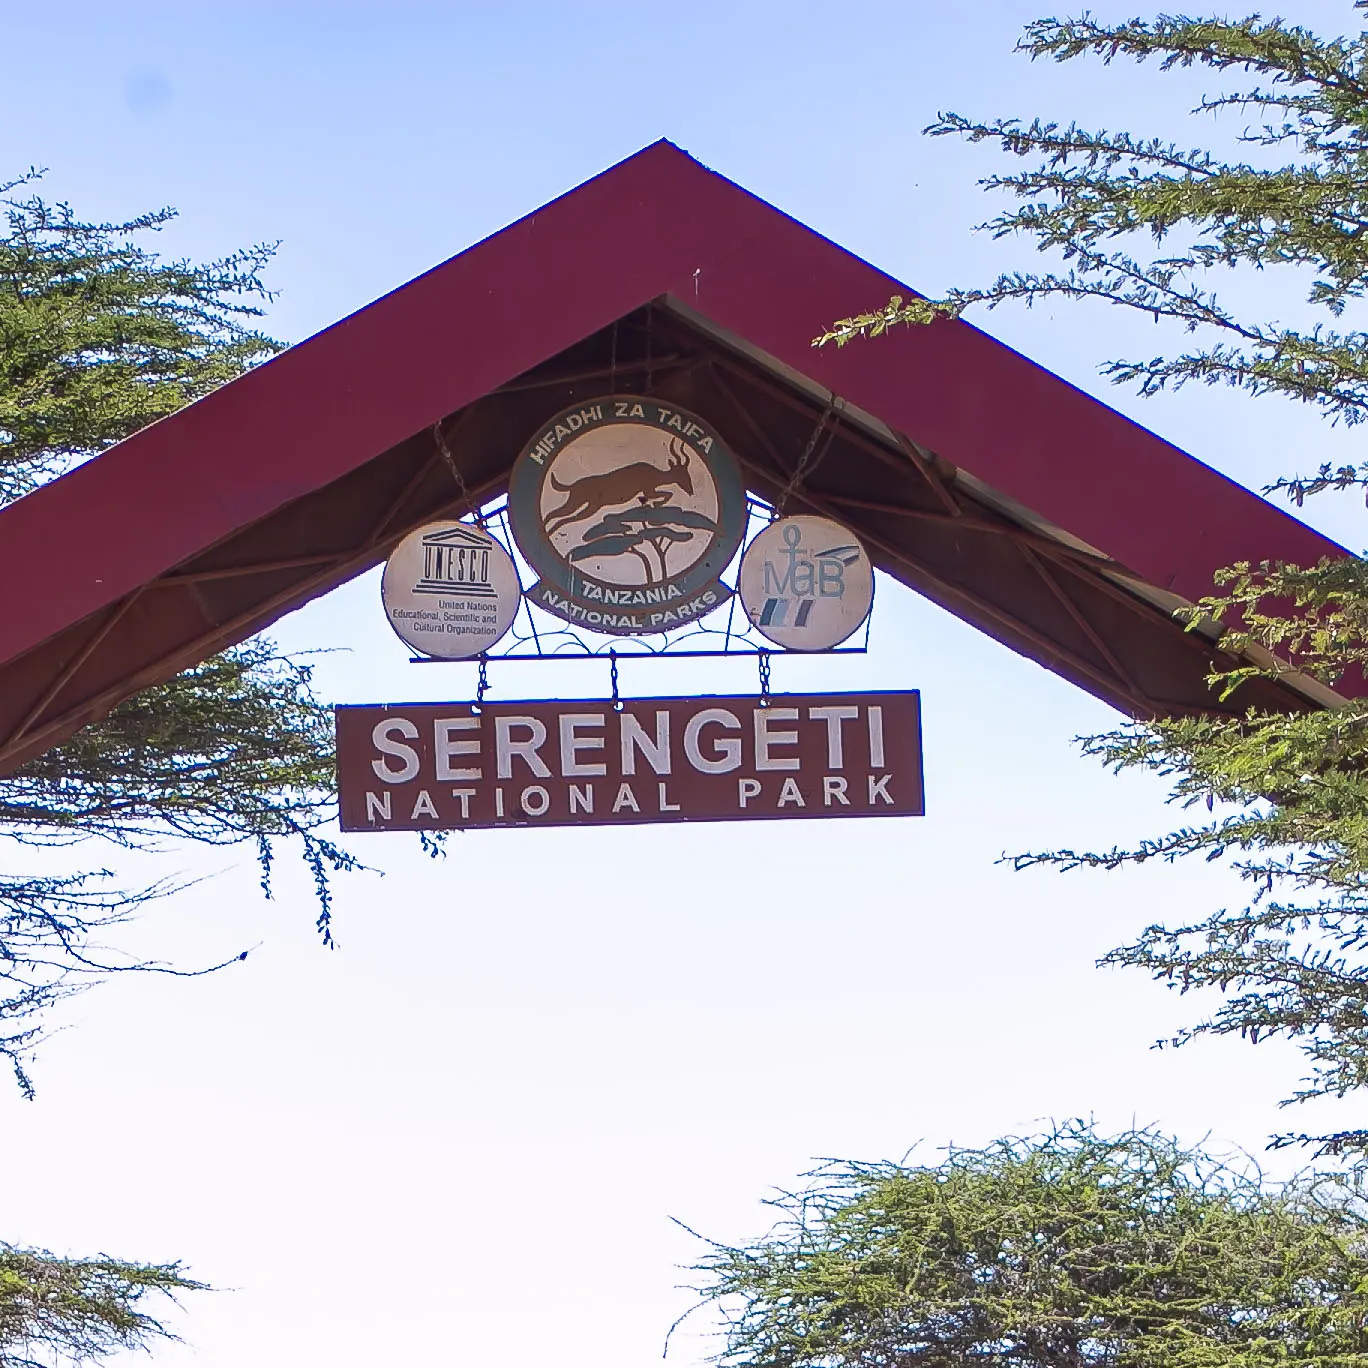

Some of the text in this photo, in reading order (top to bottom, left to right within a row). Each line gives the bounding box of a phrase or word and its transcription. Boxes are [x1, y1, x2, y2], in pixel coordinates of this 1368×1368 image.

[530, 402, 714, 465] HIFADHI ZA TAIFA
[425, 546, 489, 582] UNESCO
[438, 600, 497, 612] United Nations
[542, 590, 717, 628] NATIONAL PARKS
[581, 580, 682, 604] TANZANIA
[413, 621, 497, 636] Cultural Organization
[443, 612, 480, 623] Scientific
[481, 614, 497, 624] and
[371, 705, 886, 785] SERENGETI
[366, 773, 895, 821] NATIONAL PARK
